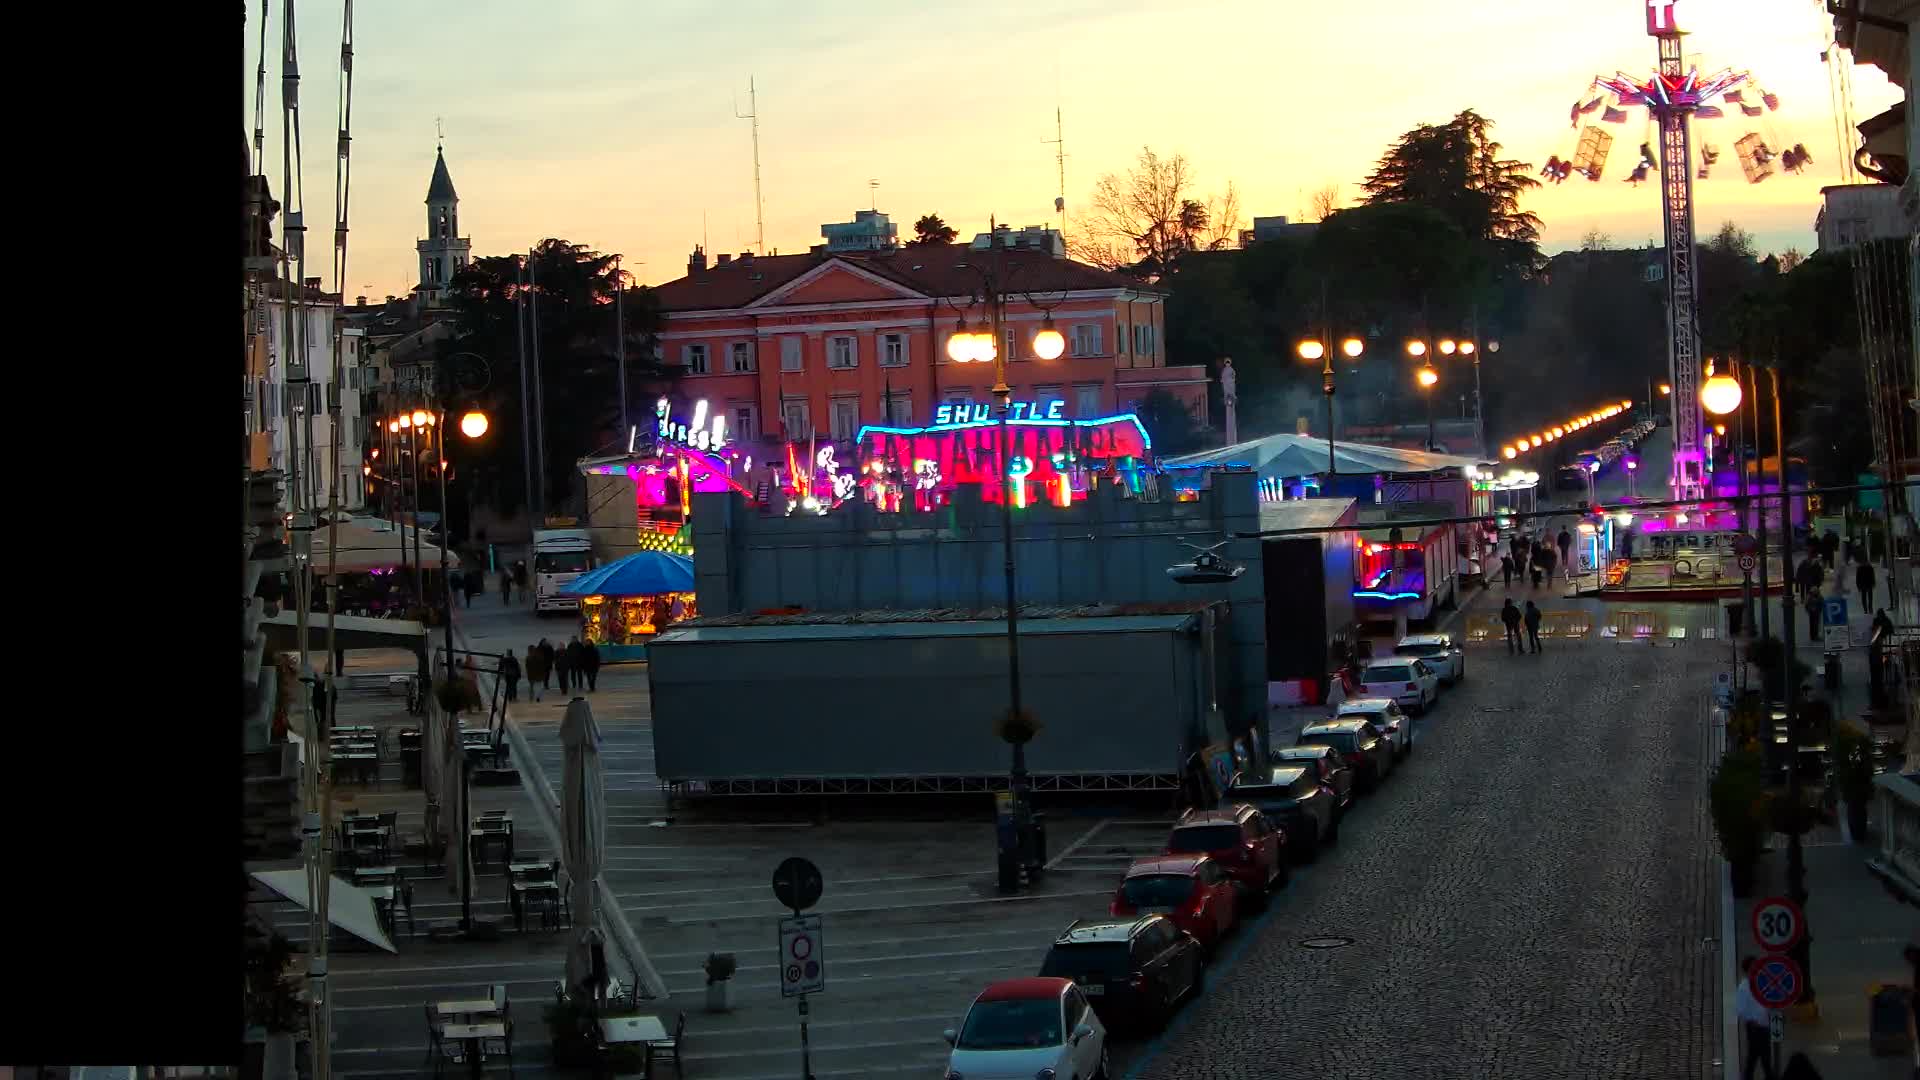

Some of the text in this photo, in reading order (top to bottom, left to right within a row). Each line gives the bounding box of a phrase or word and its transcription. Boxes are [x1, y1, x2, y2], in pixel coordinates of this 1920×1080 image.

[935, 400, 1065, 424] SHUTLE
[1827, 602, 1841, 623] P
[1761, 911, 1791, 937] 30
